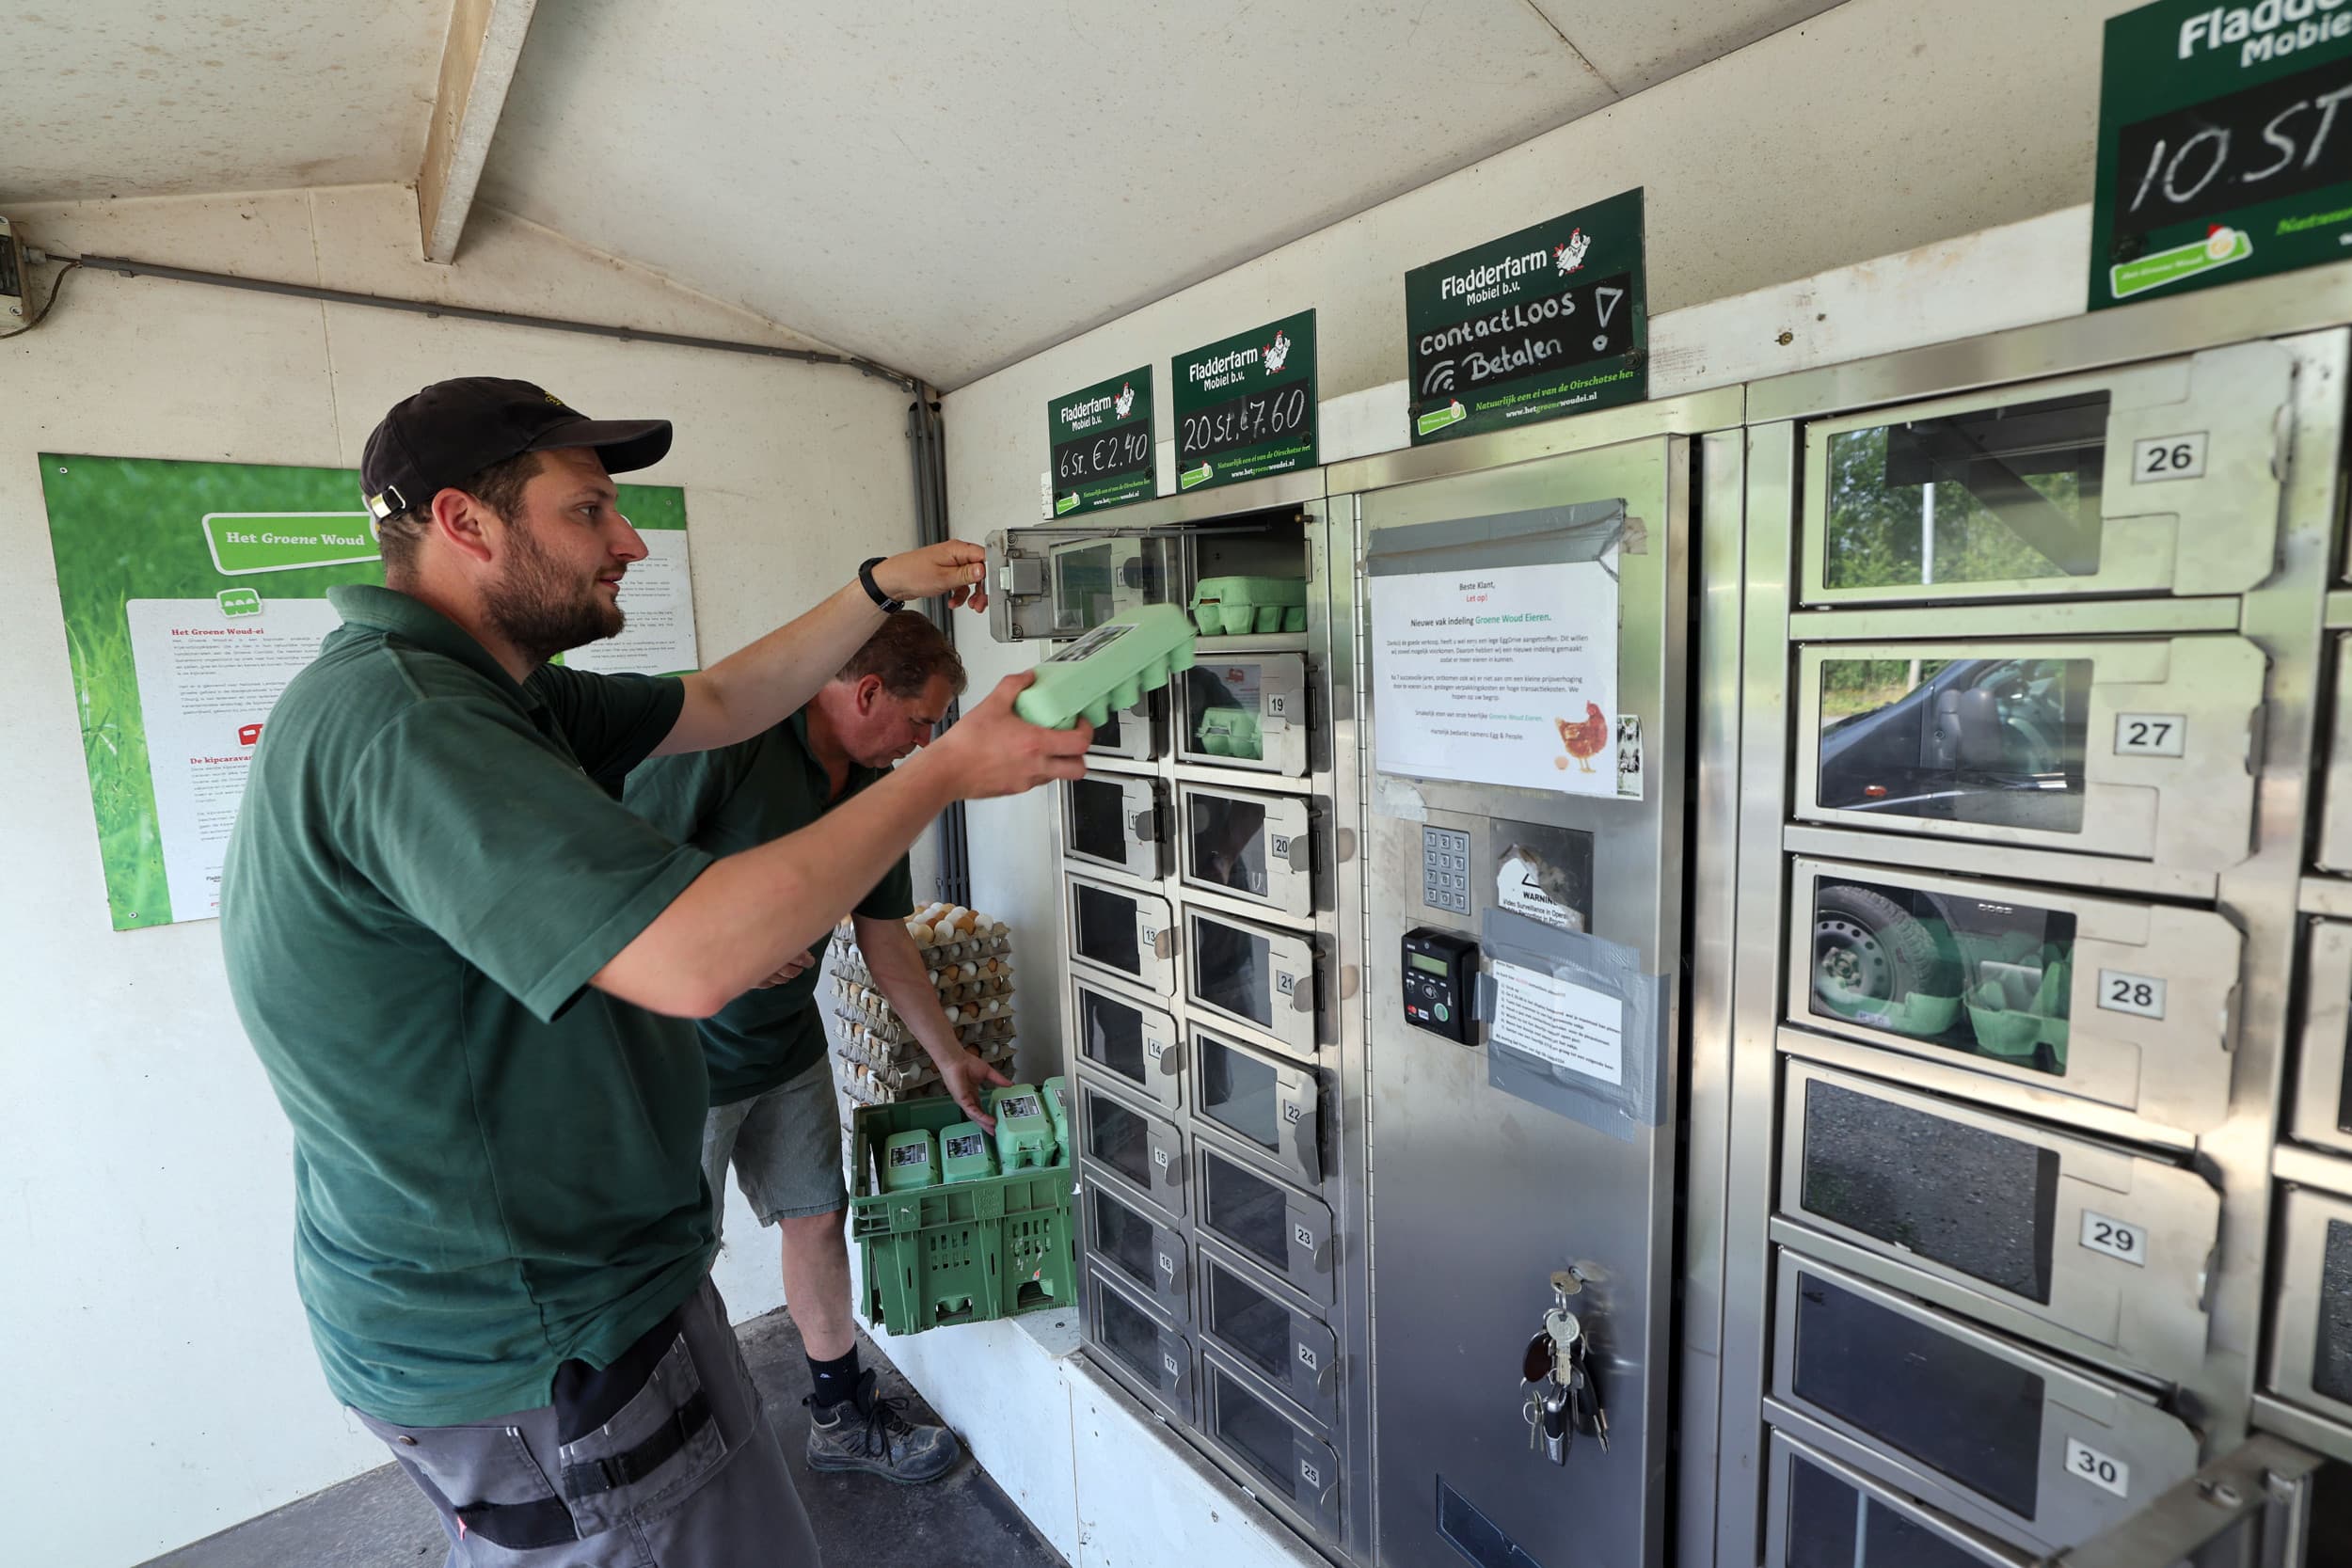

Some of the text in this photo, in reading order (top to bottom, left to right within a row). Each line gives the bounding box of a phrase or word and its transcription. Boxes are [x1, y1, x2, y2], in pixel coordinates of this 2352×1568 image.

[2178, 0, 2346, 59] Flad
[2241, 10, 2352, 68] Mobie
[1441, 249, 1548, 300] Fladderfarm
[1467, 281, 1520, 307] Mobiel b.v.
[1189, 347, 1259, 383] Fladderfarm
[1462, 338, 1563, 381] Betalen
[1204, 371, 1245, 392] Mobiel b.v.
[1475, 394, 1517, 411] Natuurlijk
[1518, 392, 1532, 403] een
[1533, 388, 1541, 399] ei
[1542, 388, 1557, 399] van
[1558, 383, 1569, 394] de
[1570, 374, 1618, 390] Oirschotse
[1060, 395, 1112, 423] Fladderfarm
[1072, 415, 1103, 432] Mobiel b.v.
[1184, 416, 1211, 452] 20
[1060, 450, 1069, 478] 6
[2144, 442, 2193, 473] 26
[226, 531, 365, 546] Het Groene Woud
[1459, 581, 1495, 591] Beste Klant,
[1410, 613, 1551, 627] Nieuwe vak indeling Groene Woud Eieren.
[191, 627, 225, 636] Groene
[1271, 697, 1283, 713] 19
[2126, 721, 2172, 749] 27
[1276, 839, 1288, 853] 20
[1523, 891, 1558, 906] WARNIN
[1146, 929, 1155, 942] 13
[1280, 974, 1293, 990] 21
[2111, 979, 2154, 1007] 28
[1152, 1042, 1161, 1055] 14
[1288, 1105, 1300, 1121] 22
[1156, 1151, 1167, 1164] 15
[1297, 1227, 1311, 1244] 23
[2092, 1221, 2136, 1254] 29
[1161, 1257, 1171, 1271] 16
[1166, 1357, 1176, 1370] 17
[1301, 1347, 1314, 1365] 24
[1304, 1465, 1318, 1483] 25
[2076, 1449, 2119, 1486] 30
